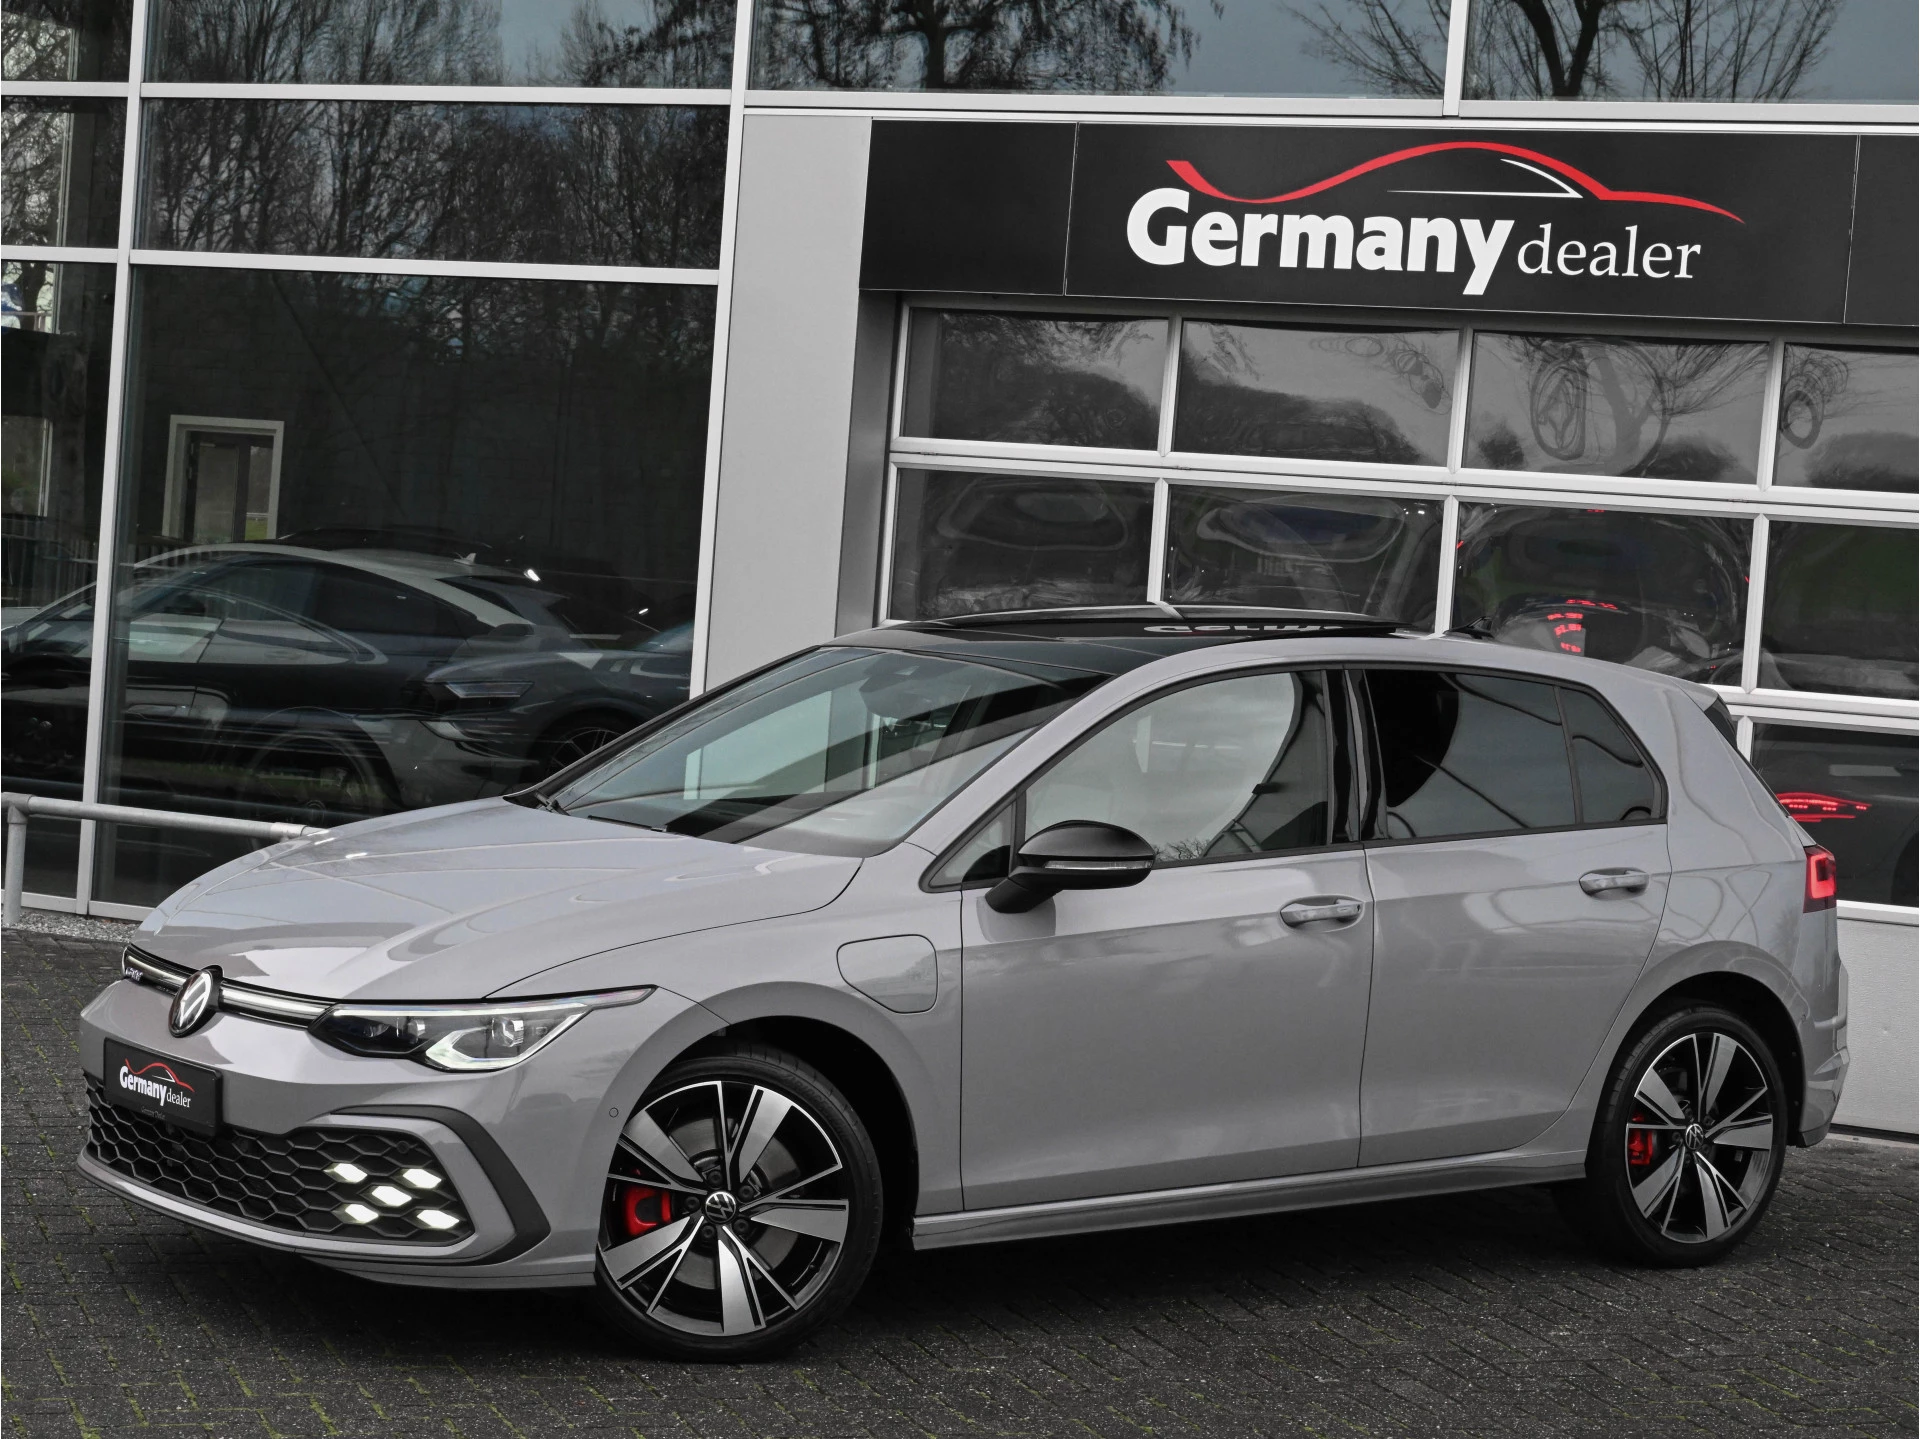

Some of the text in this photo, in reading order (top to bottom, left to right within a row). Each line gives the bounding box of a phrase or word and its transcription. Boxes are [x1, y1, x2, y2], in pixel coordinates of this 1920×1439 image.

[1126, 187, 1702, 295] Germany dealer
[119, 1065, 192, 1108] Germany dealer
